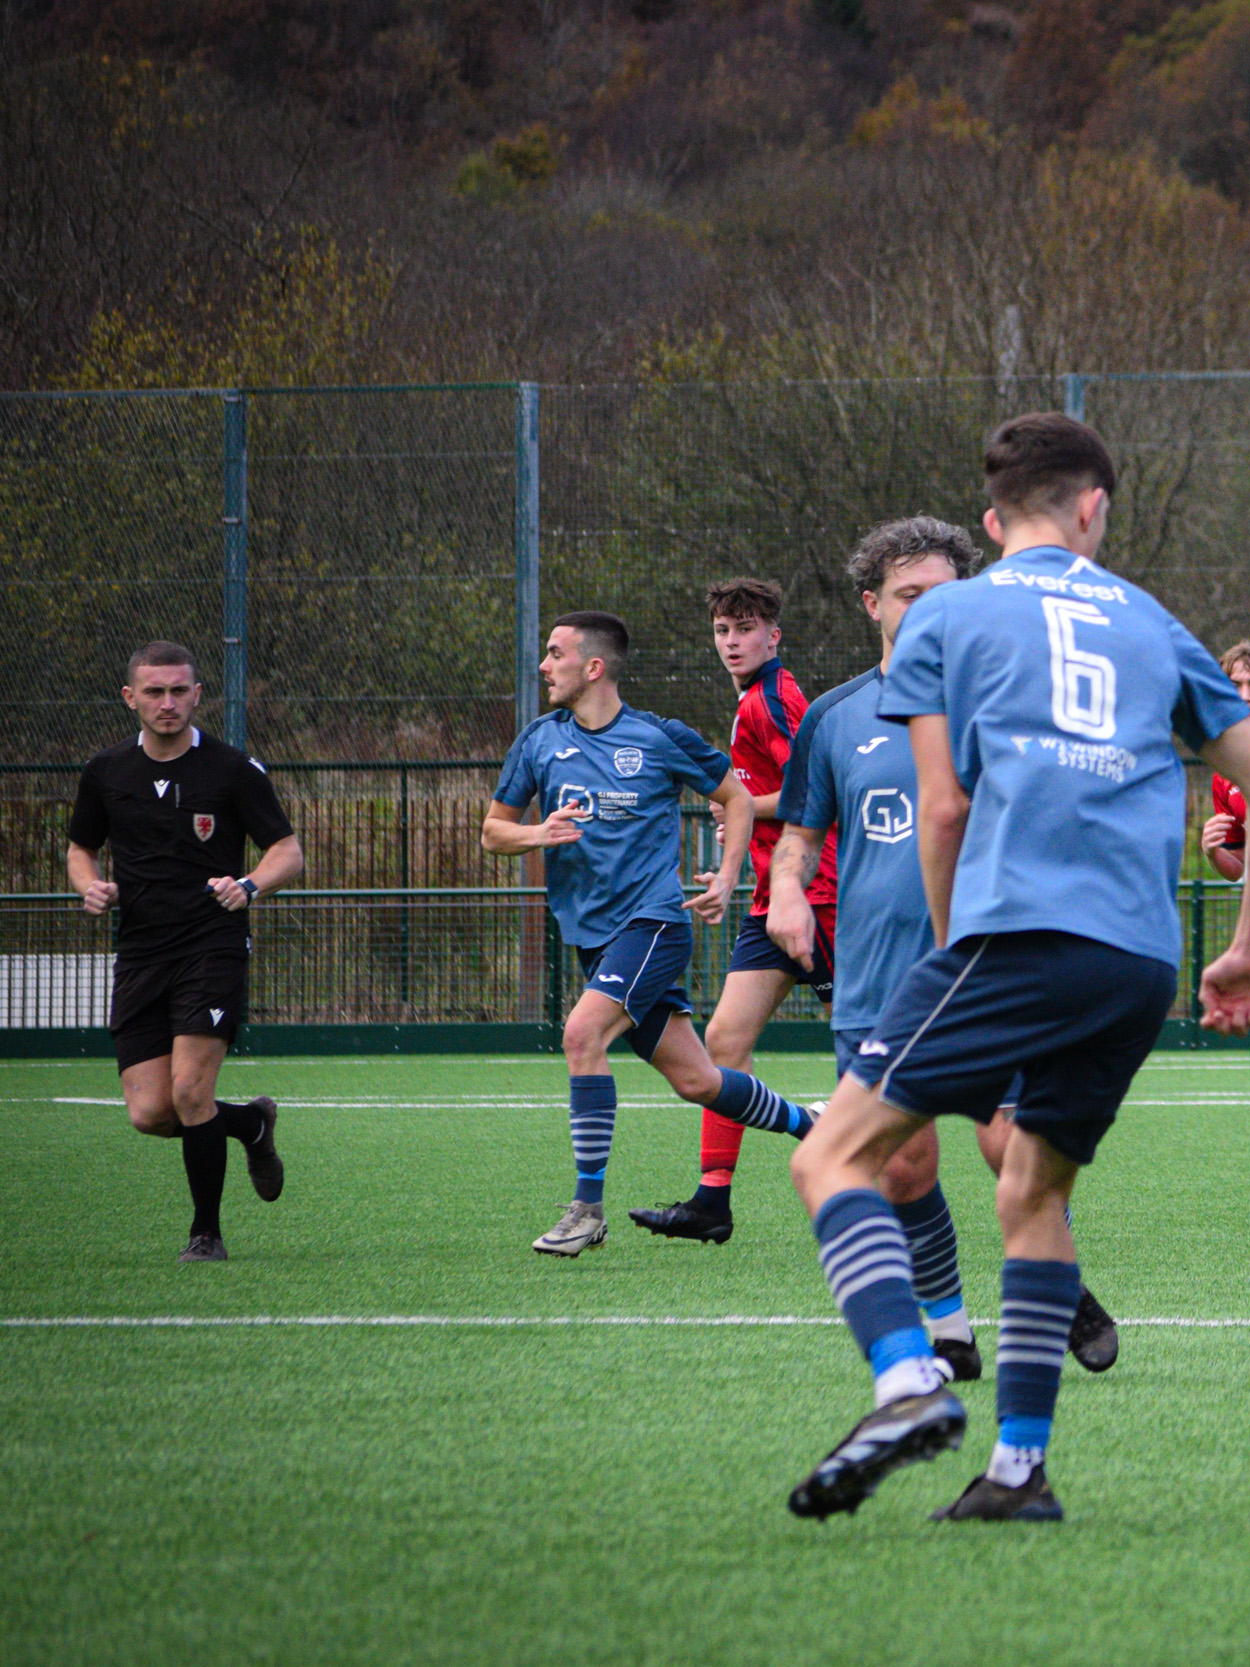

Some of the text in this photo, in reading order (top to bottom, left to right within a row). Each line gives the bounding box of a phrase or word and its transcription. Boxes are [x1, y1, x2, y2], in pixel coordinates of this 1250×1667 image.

[989, 569, 1128, 605] Everest
[1041, 596, 1116, 739] 6
[1058, 751, 1125, 783] SYSTEMS
[607, 792, 639, 800] PROPERTY
